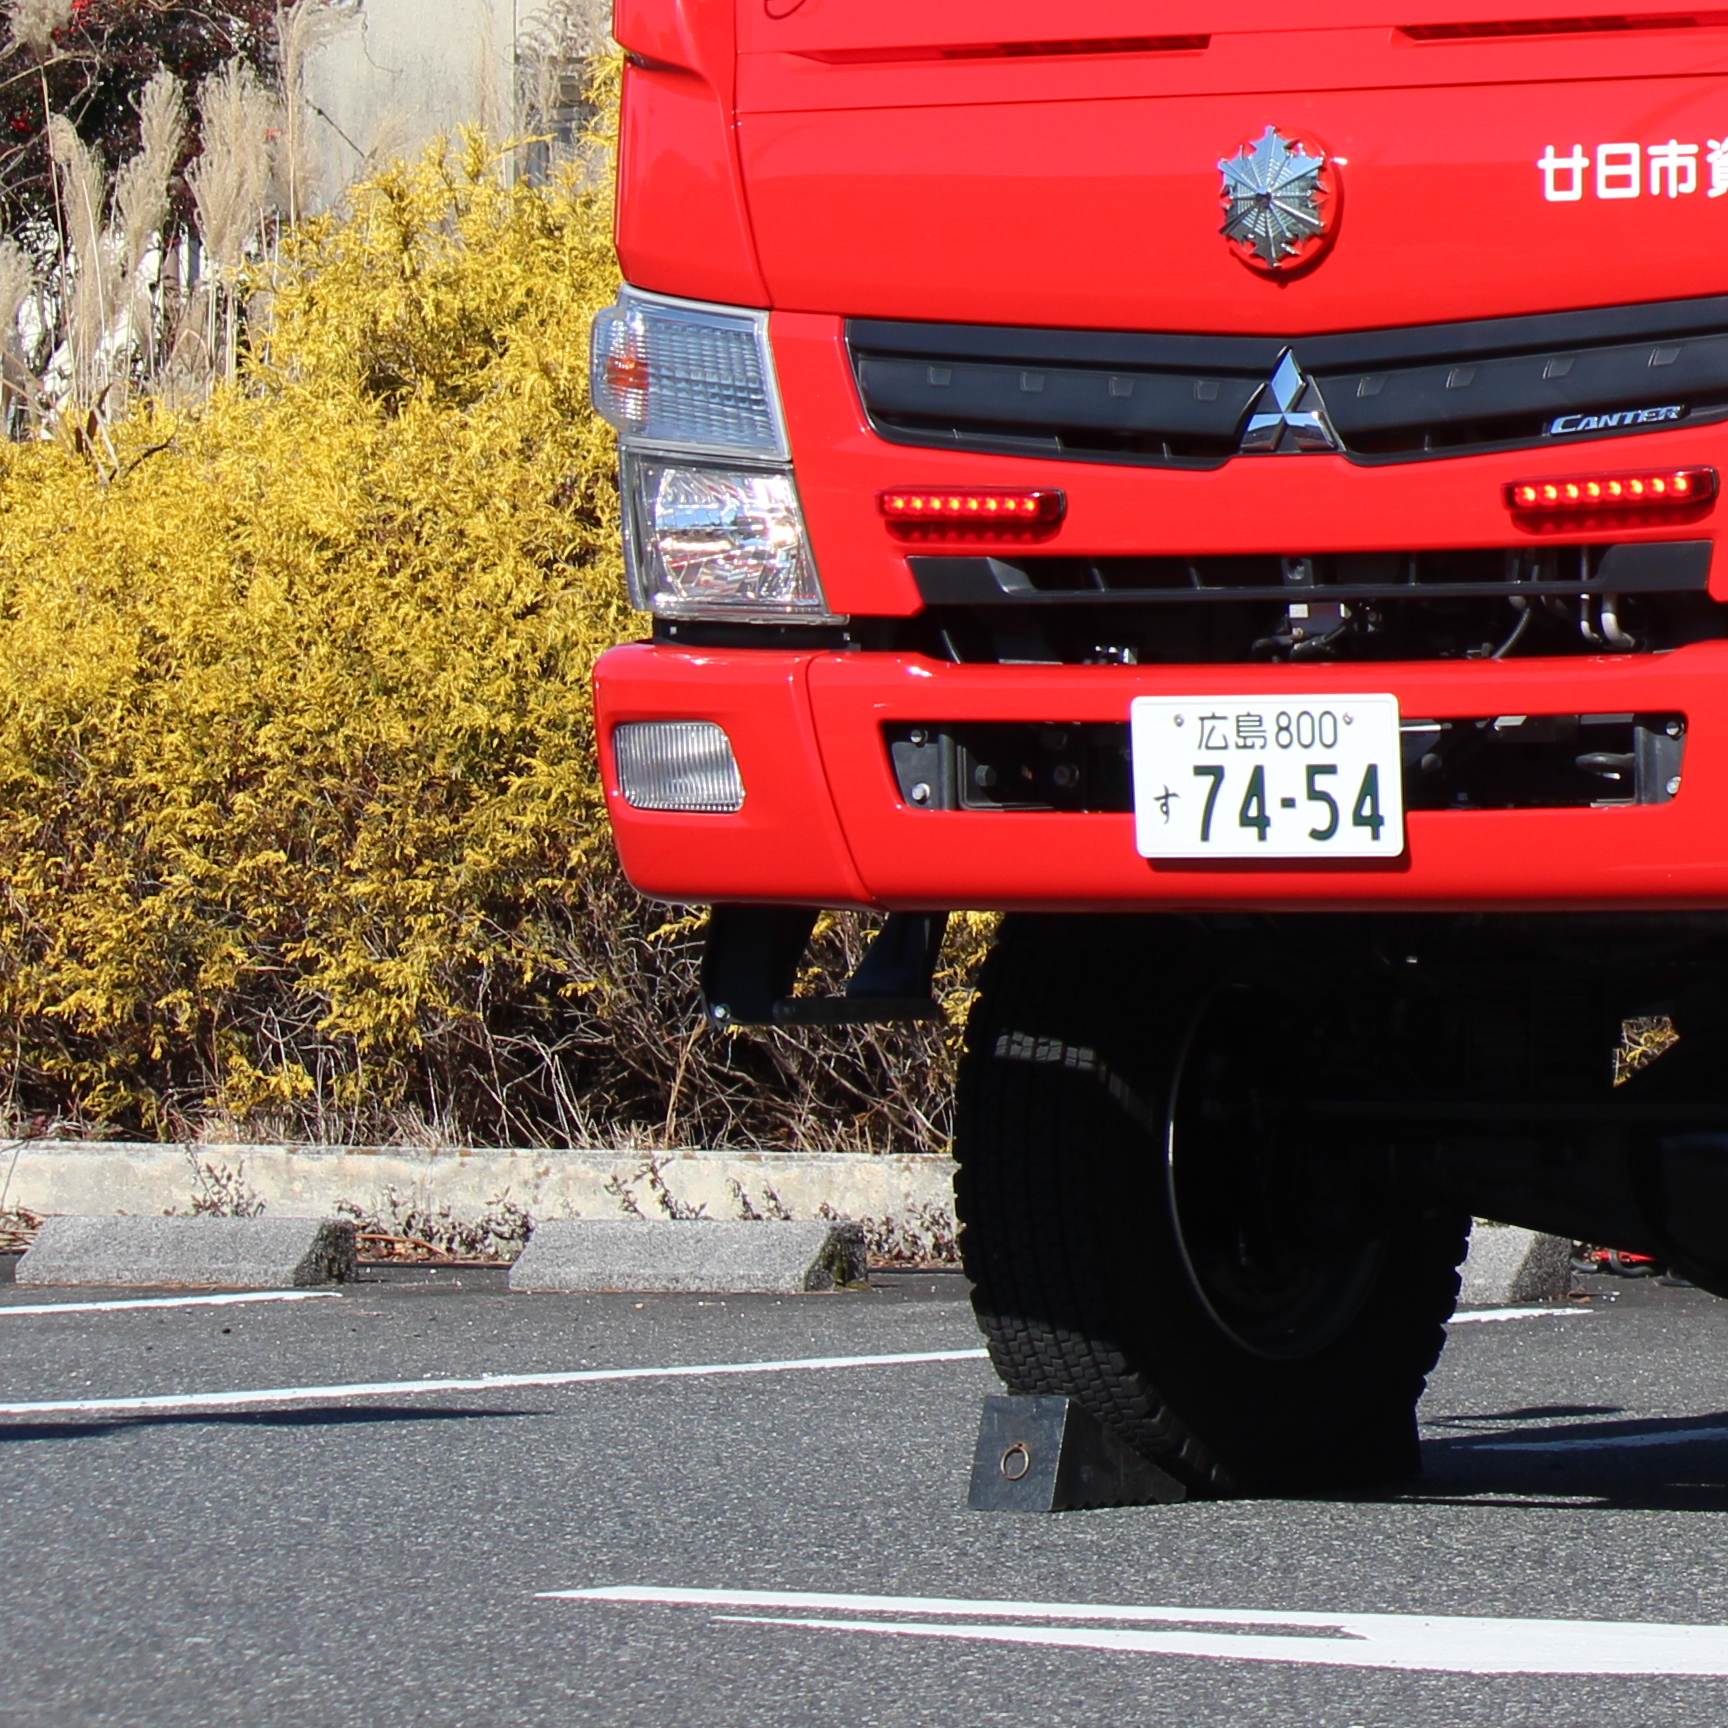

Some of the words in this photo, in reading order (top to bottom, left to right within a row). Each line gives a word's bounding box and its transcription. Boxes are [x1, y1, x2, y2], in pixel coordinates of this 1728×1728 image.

[1550, 405, 1682, 434] CANTER
[1198, 712, 1268, 750] 広島
[1275, 710, 1338, 749] 800
[1153, 785, 1180, 824] す
[1193, 764, 1384, 842] 74-54
